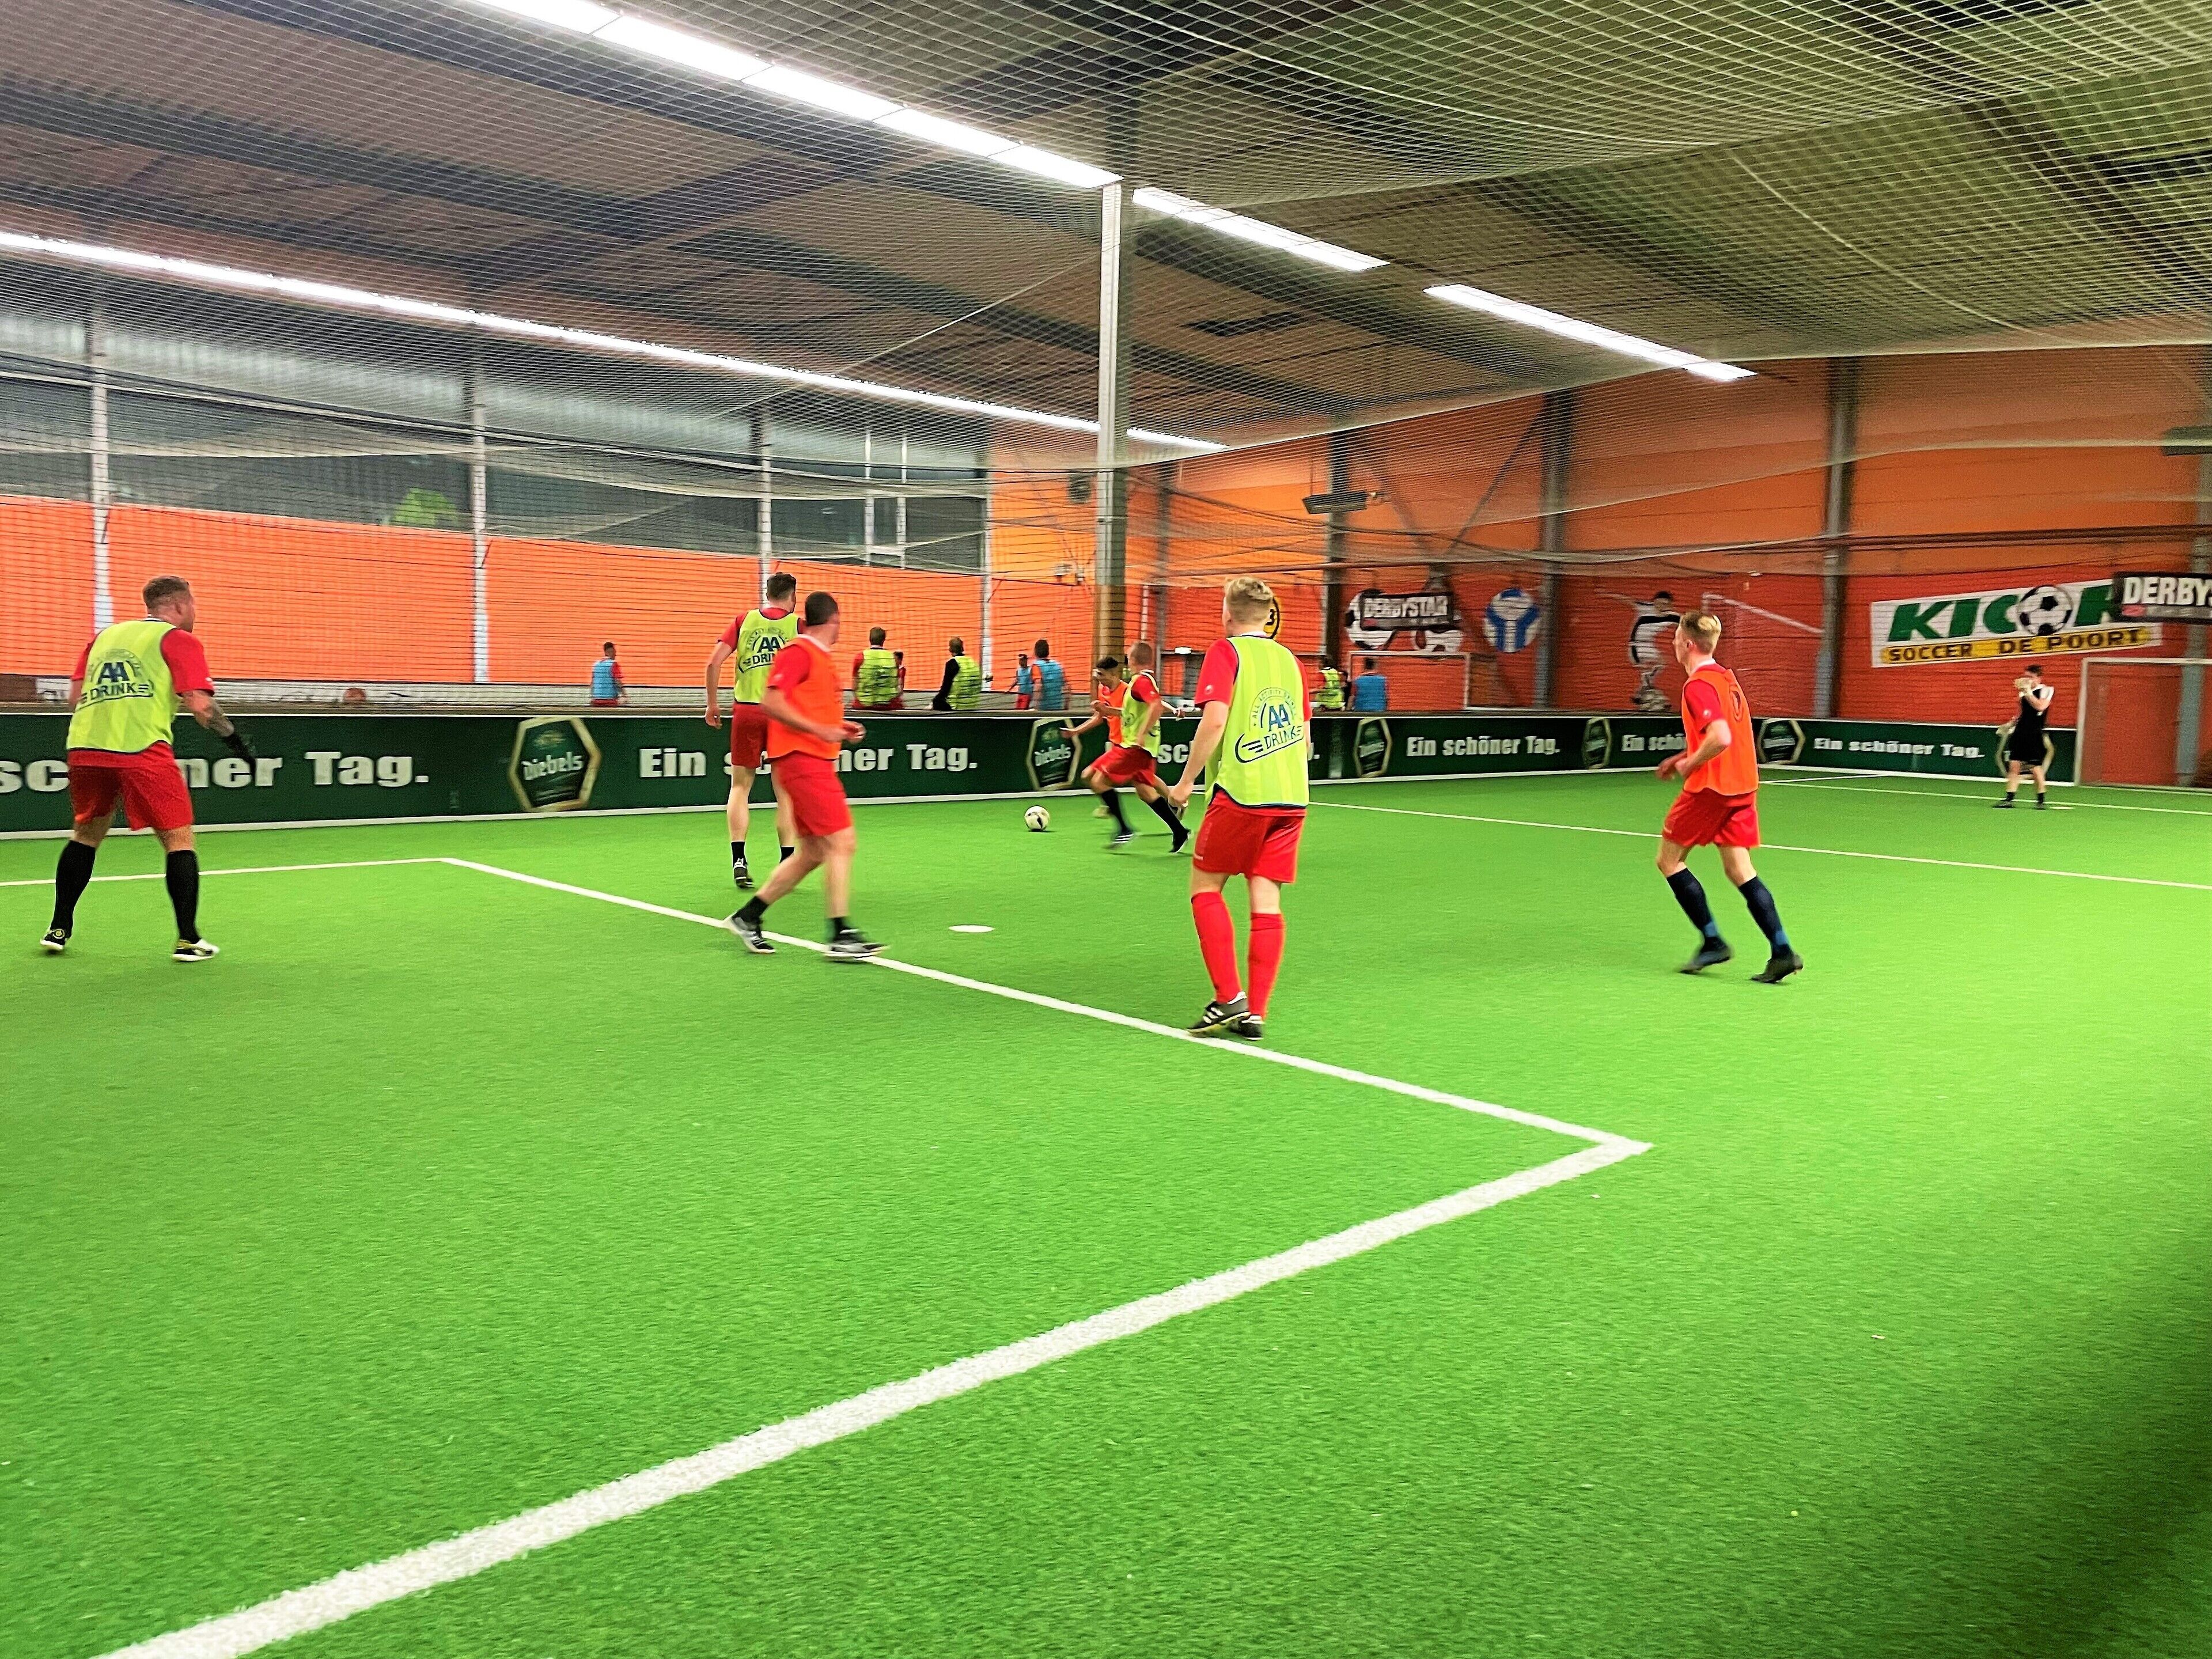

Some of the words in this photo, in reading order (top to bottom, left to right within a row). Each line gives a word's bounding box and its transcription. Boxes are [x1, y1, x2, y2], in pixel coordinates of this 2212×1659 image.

[2122, 577, 2212, 606] DERBY
[1889, 643, 1972, 661] SOCCER
[1999, 639, 2034, 654] DE
[2048, 628, 2139, 650] POORT
[752, 653, 775, 664] DRI
[97, 662, 130, 684] AA
[90, 682, 137, 700] DRINK
[1268, 704, 1291, 732] AA
[1264, 726, 1297, 749] DRINK
[1406, 737, 1437, 756] Ein
[1442, 736, 1521, 756] schöner
[1525, 736, 1560, 755] Tag.
[1621, 734, 1645, 751] Ein
[1648, 733, 1687, 751] schö
[1813, 738, 1843, 750] Ein
[1848, 741, 1934, 755] schöner
[639, 748, 706, 778] Ein
[906, 744, 978, 771] Tag.
[0, 757, 282, 793] scner
[304, 752, 429, 787] Tag.
